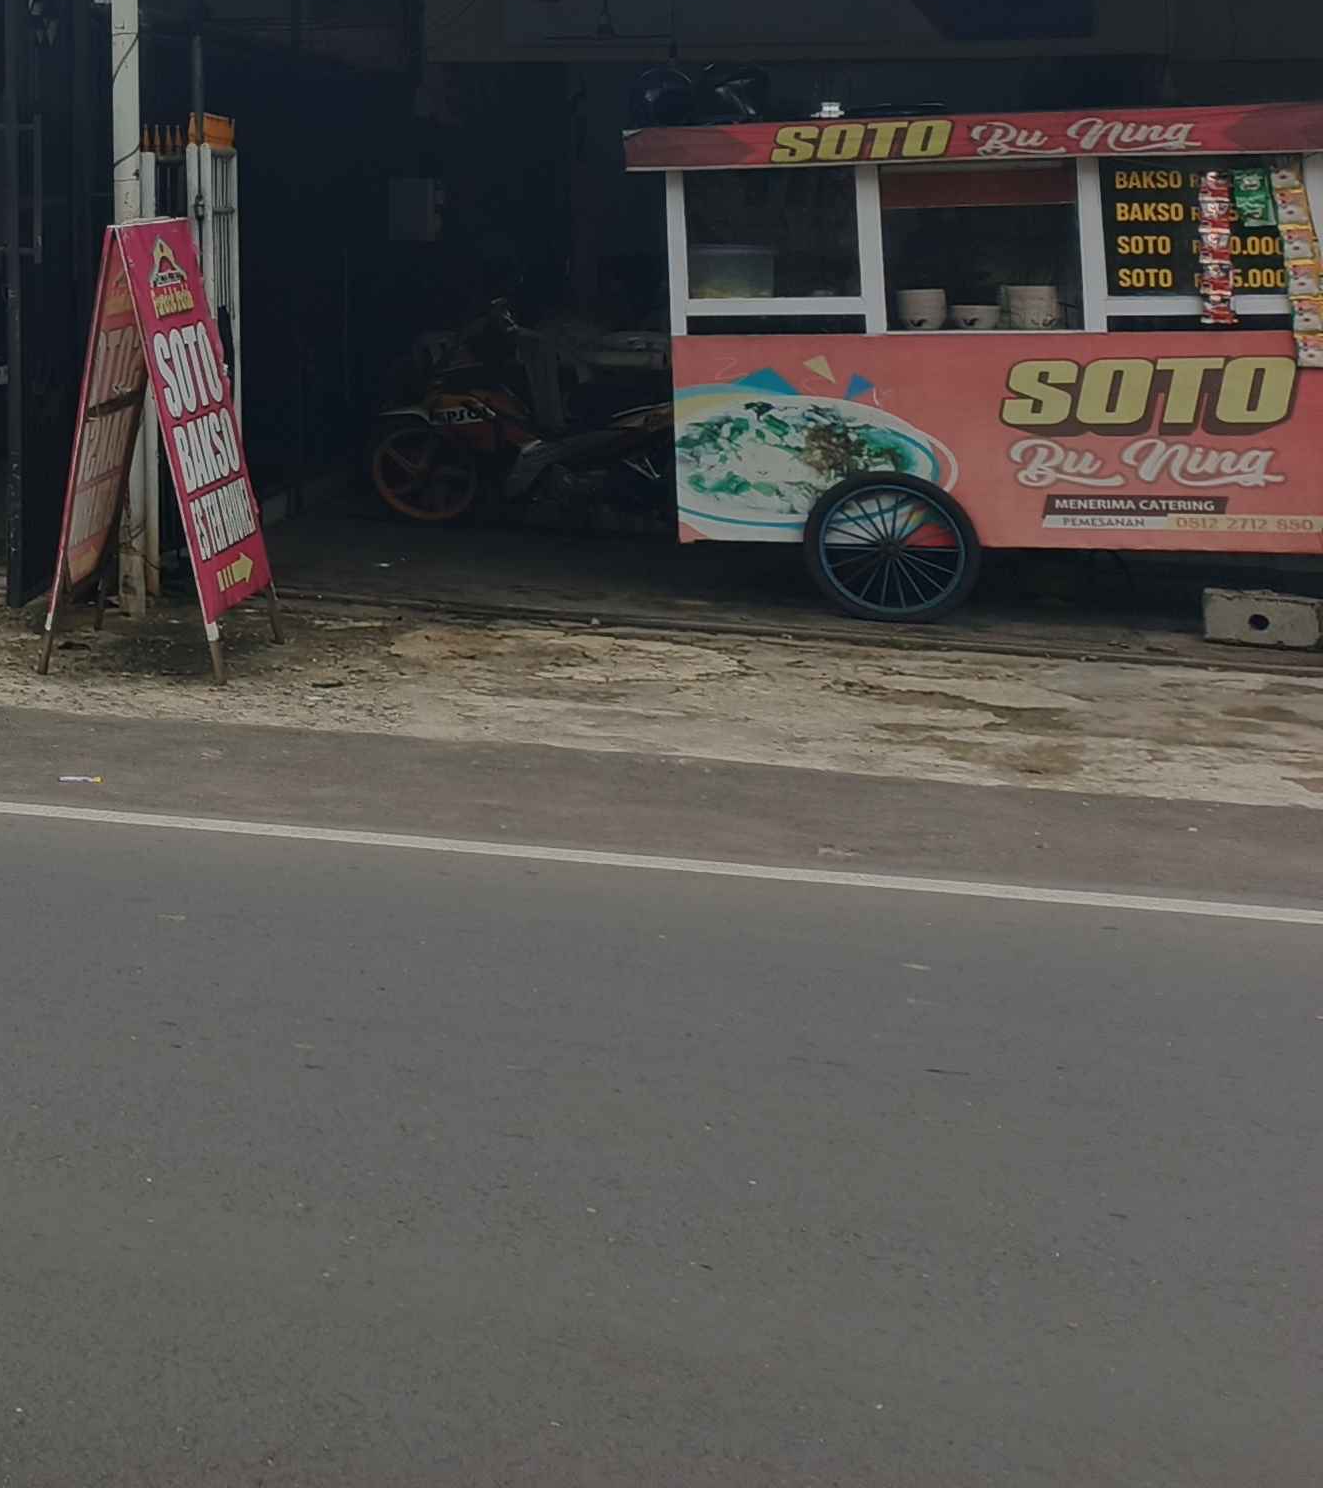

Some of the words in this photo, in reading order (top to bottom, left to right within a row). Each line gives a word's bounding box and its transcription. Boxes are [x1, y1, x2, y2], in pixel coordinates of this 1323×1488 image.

[771, 119, 954, 164] SOTO
[970, 121, 1067, 157] Bu
[1067, 118, 1205, 153] Ning
[1114, 170, 1183, 190] BAKSO
[1115, 202, 1185, 222] BAKSO
[1116, 235, 1172, 256] SOTO
[1118, 267, 1174, 289] SOTO
[153, 320, 224, 420] SOTO
[1000, 355, 1298, 433] SOTO
[172, 407, 241, 495] BAKSO
[1010, 438, 1127, 488] Bu
[1121, 438, 1286, 488] Ning
[1055, 498, 1136, 510] MENERIMA
[1139, 499, 1215, 512] CATERING
